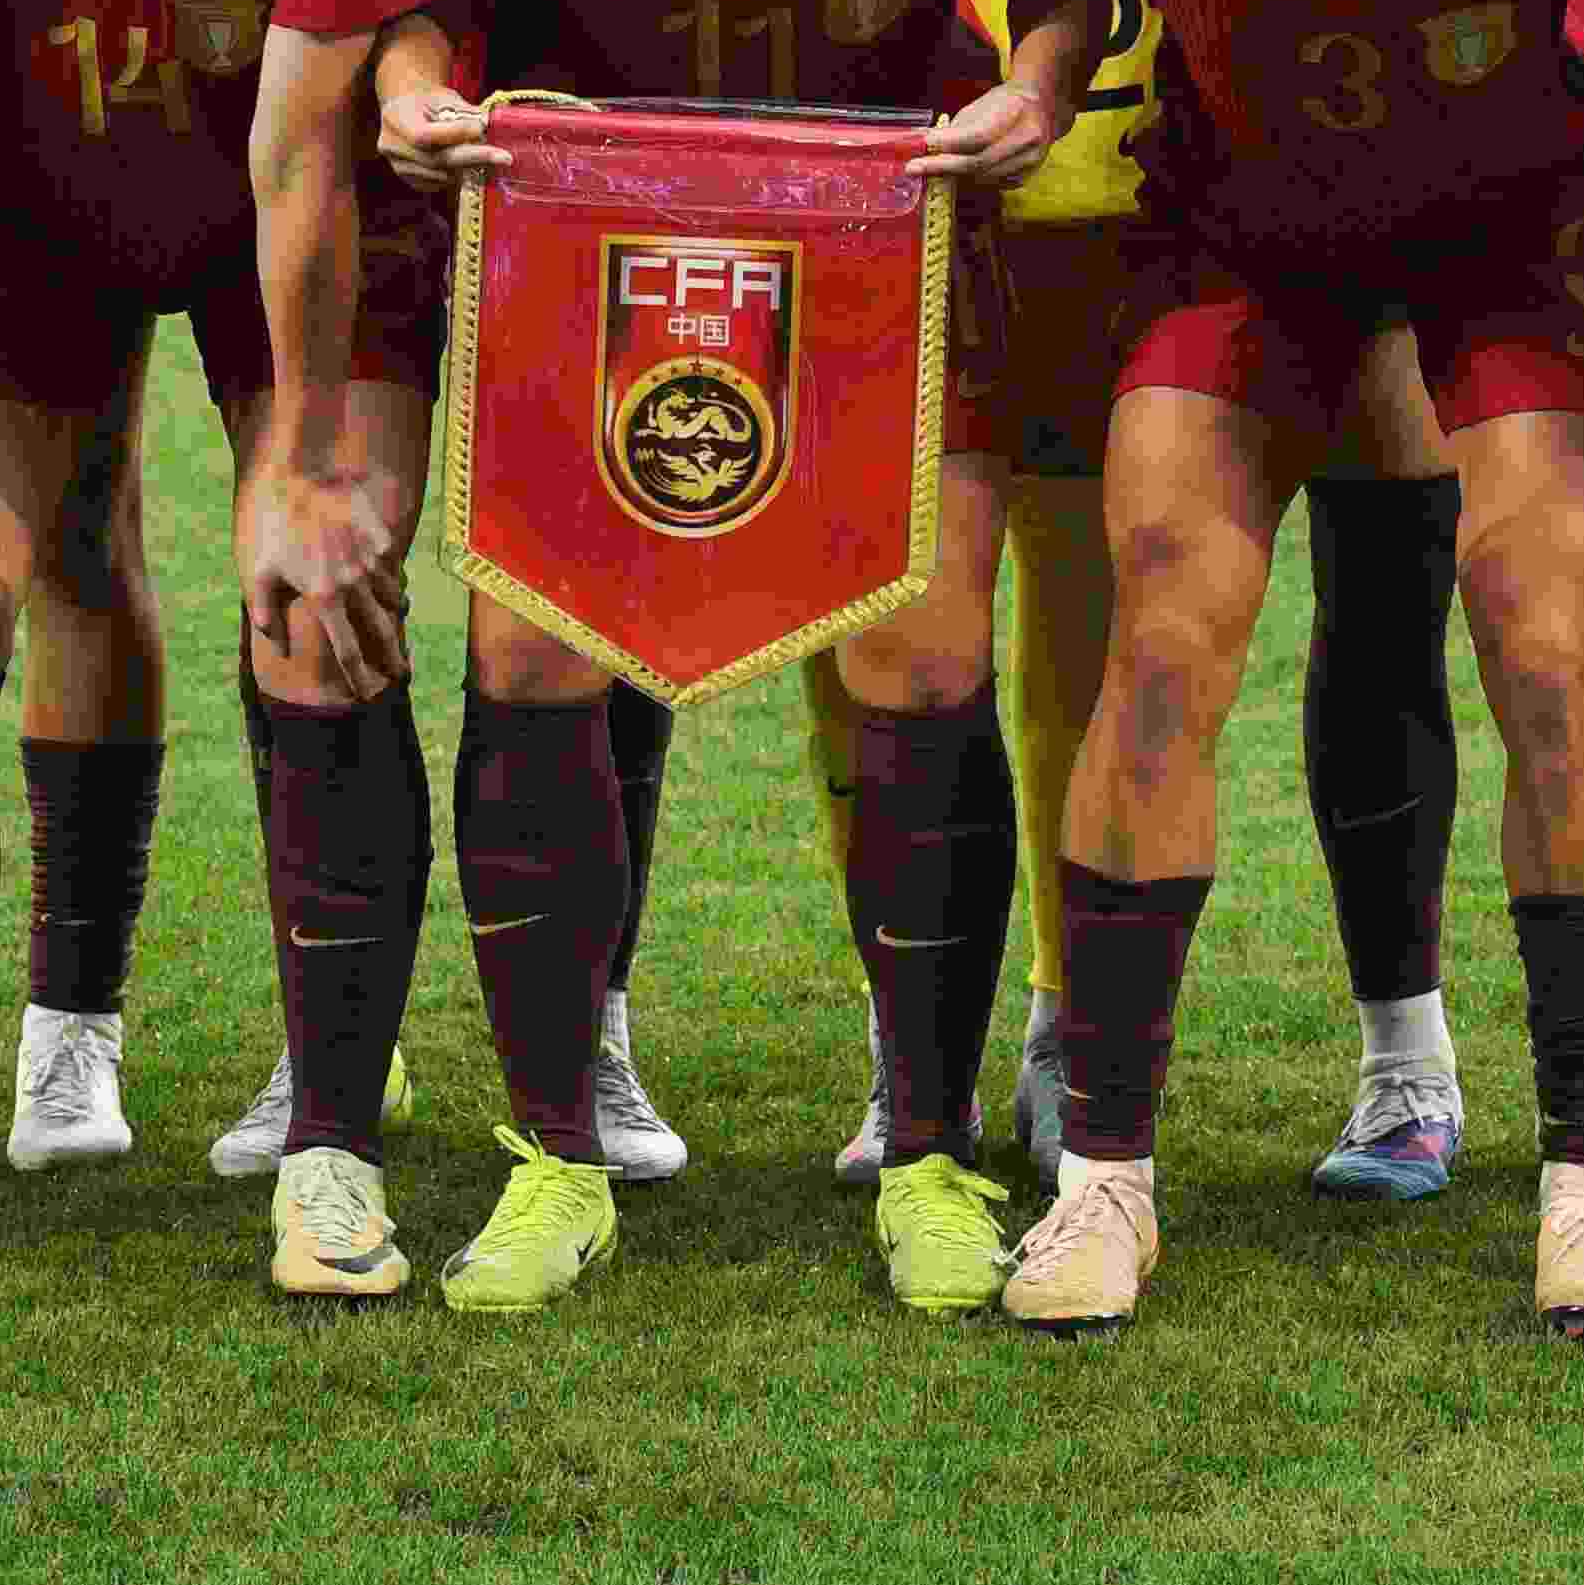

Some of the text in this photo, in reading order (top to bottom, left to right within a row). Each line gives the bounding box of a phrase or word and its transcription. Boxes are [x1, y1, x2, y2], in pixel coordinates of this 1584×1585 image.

[47, 16, 192, 136] 14
[661, 0, 797, 97] 11
[1299, 32, 1391, 130] 3
[620, 256, 782, 311] CFA
